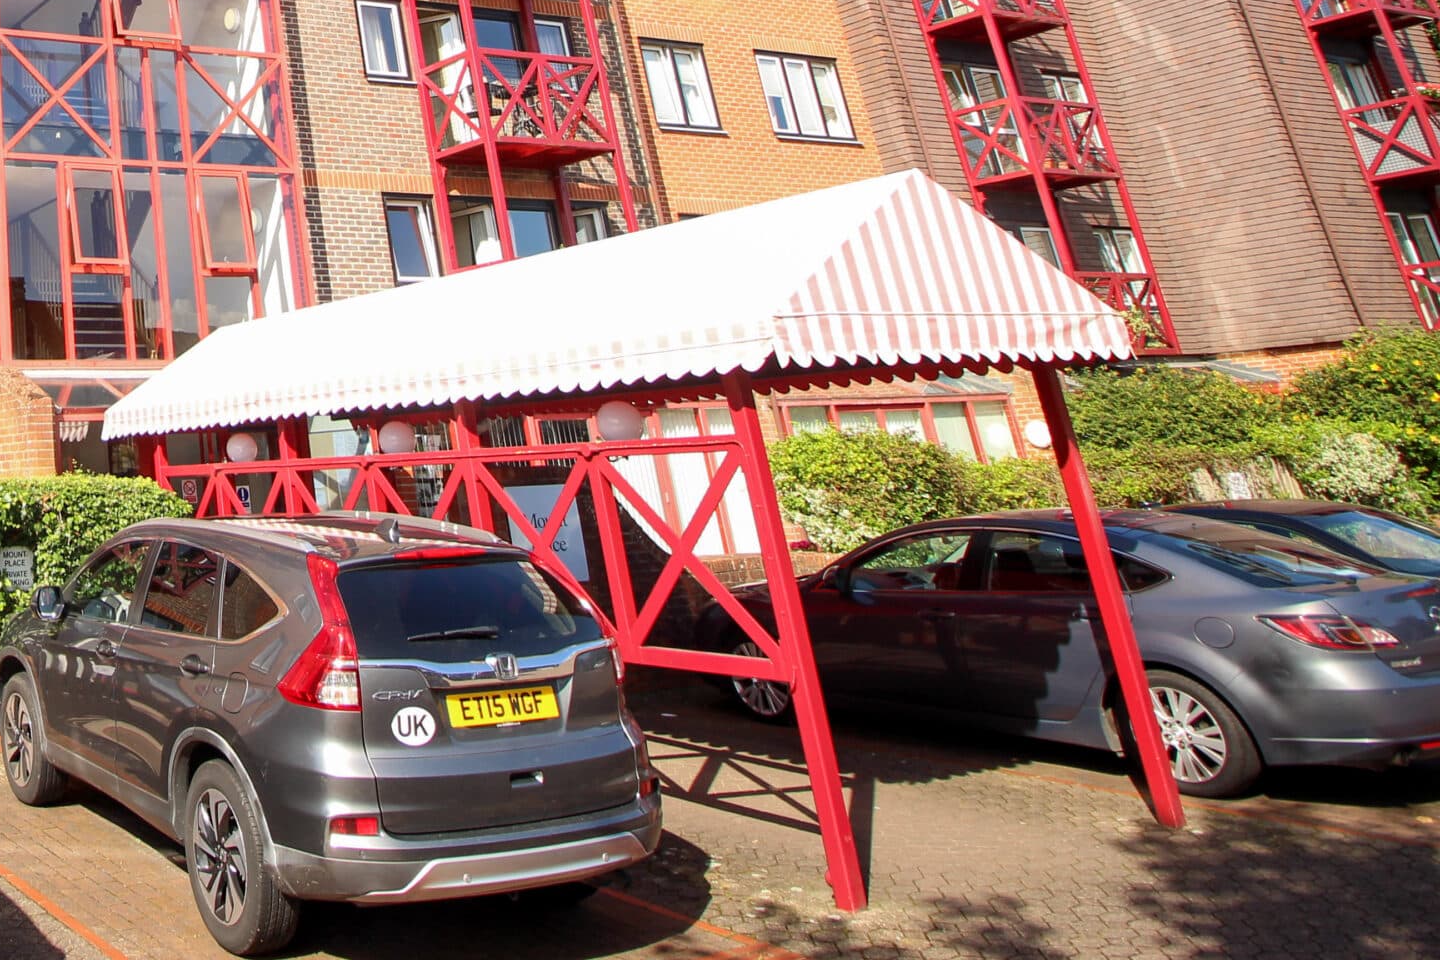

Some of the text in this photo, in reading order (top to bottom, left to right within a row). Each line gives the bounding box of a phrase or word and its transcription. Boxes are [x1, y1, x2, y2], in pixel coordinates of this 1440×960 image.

[4, 559, 26, 567] PLACE
[6, 570, 27, 578] RIVATE
[459, 690, 543, 721] ET15 WGF
[396, 713, 429, 738] UK
